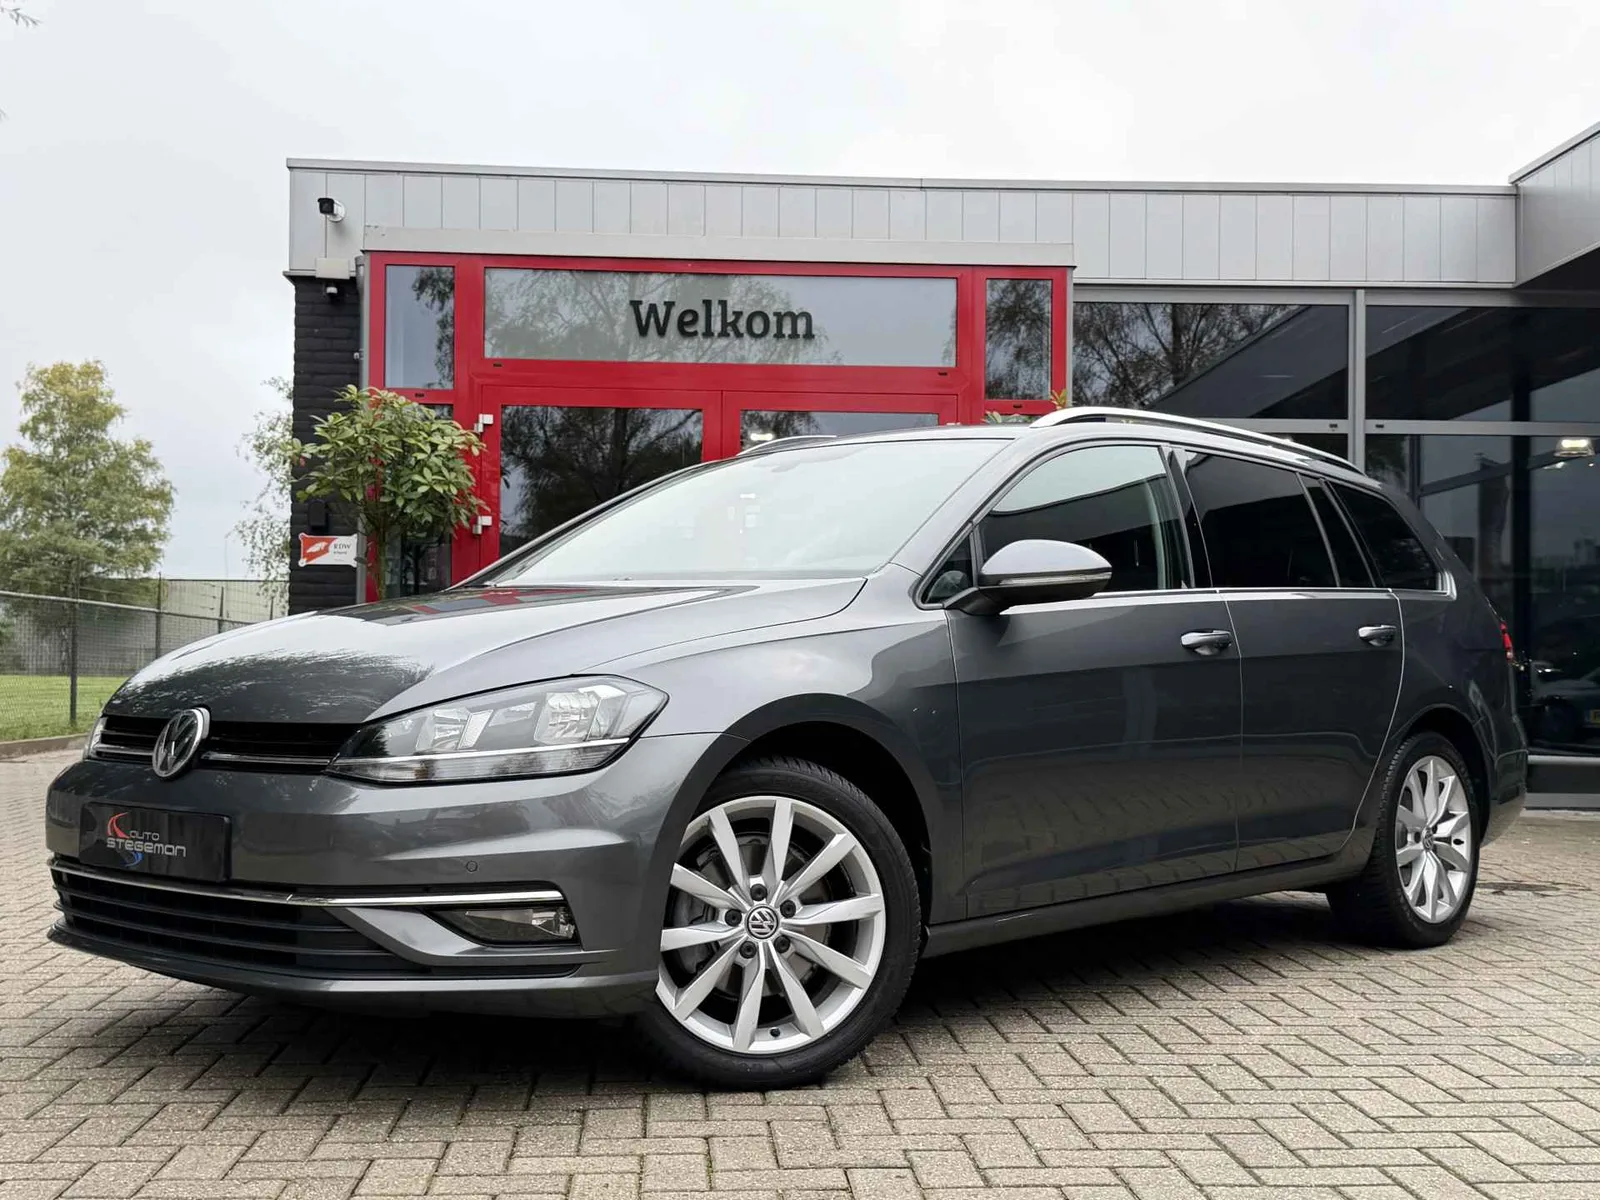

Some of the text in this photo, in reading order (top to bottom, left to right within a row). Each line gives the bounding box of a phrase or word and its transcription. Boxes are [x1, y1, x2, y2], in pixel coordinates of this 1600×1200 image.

[629, 299, 815, 340] Welkom
[129, 830, 160, 841] AUTO
[106, 837, 187, 858] STEGEMAN
